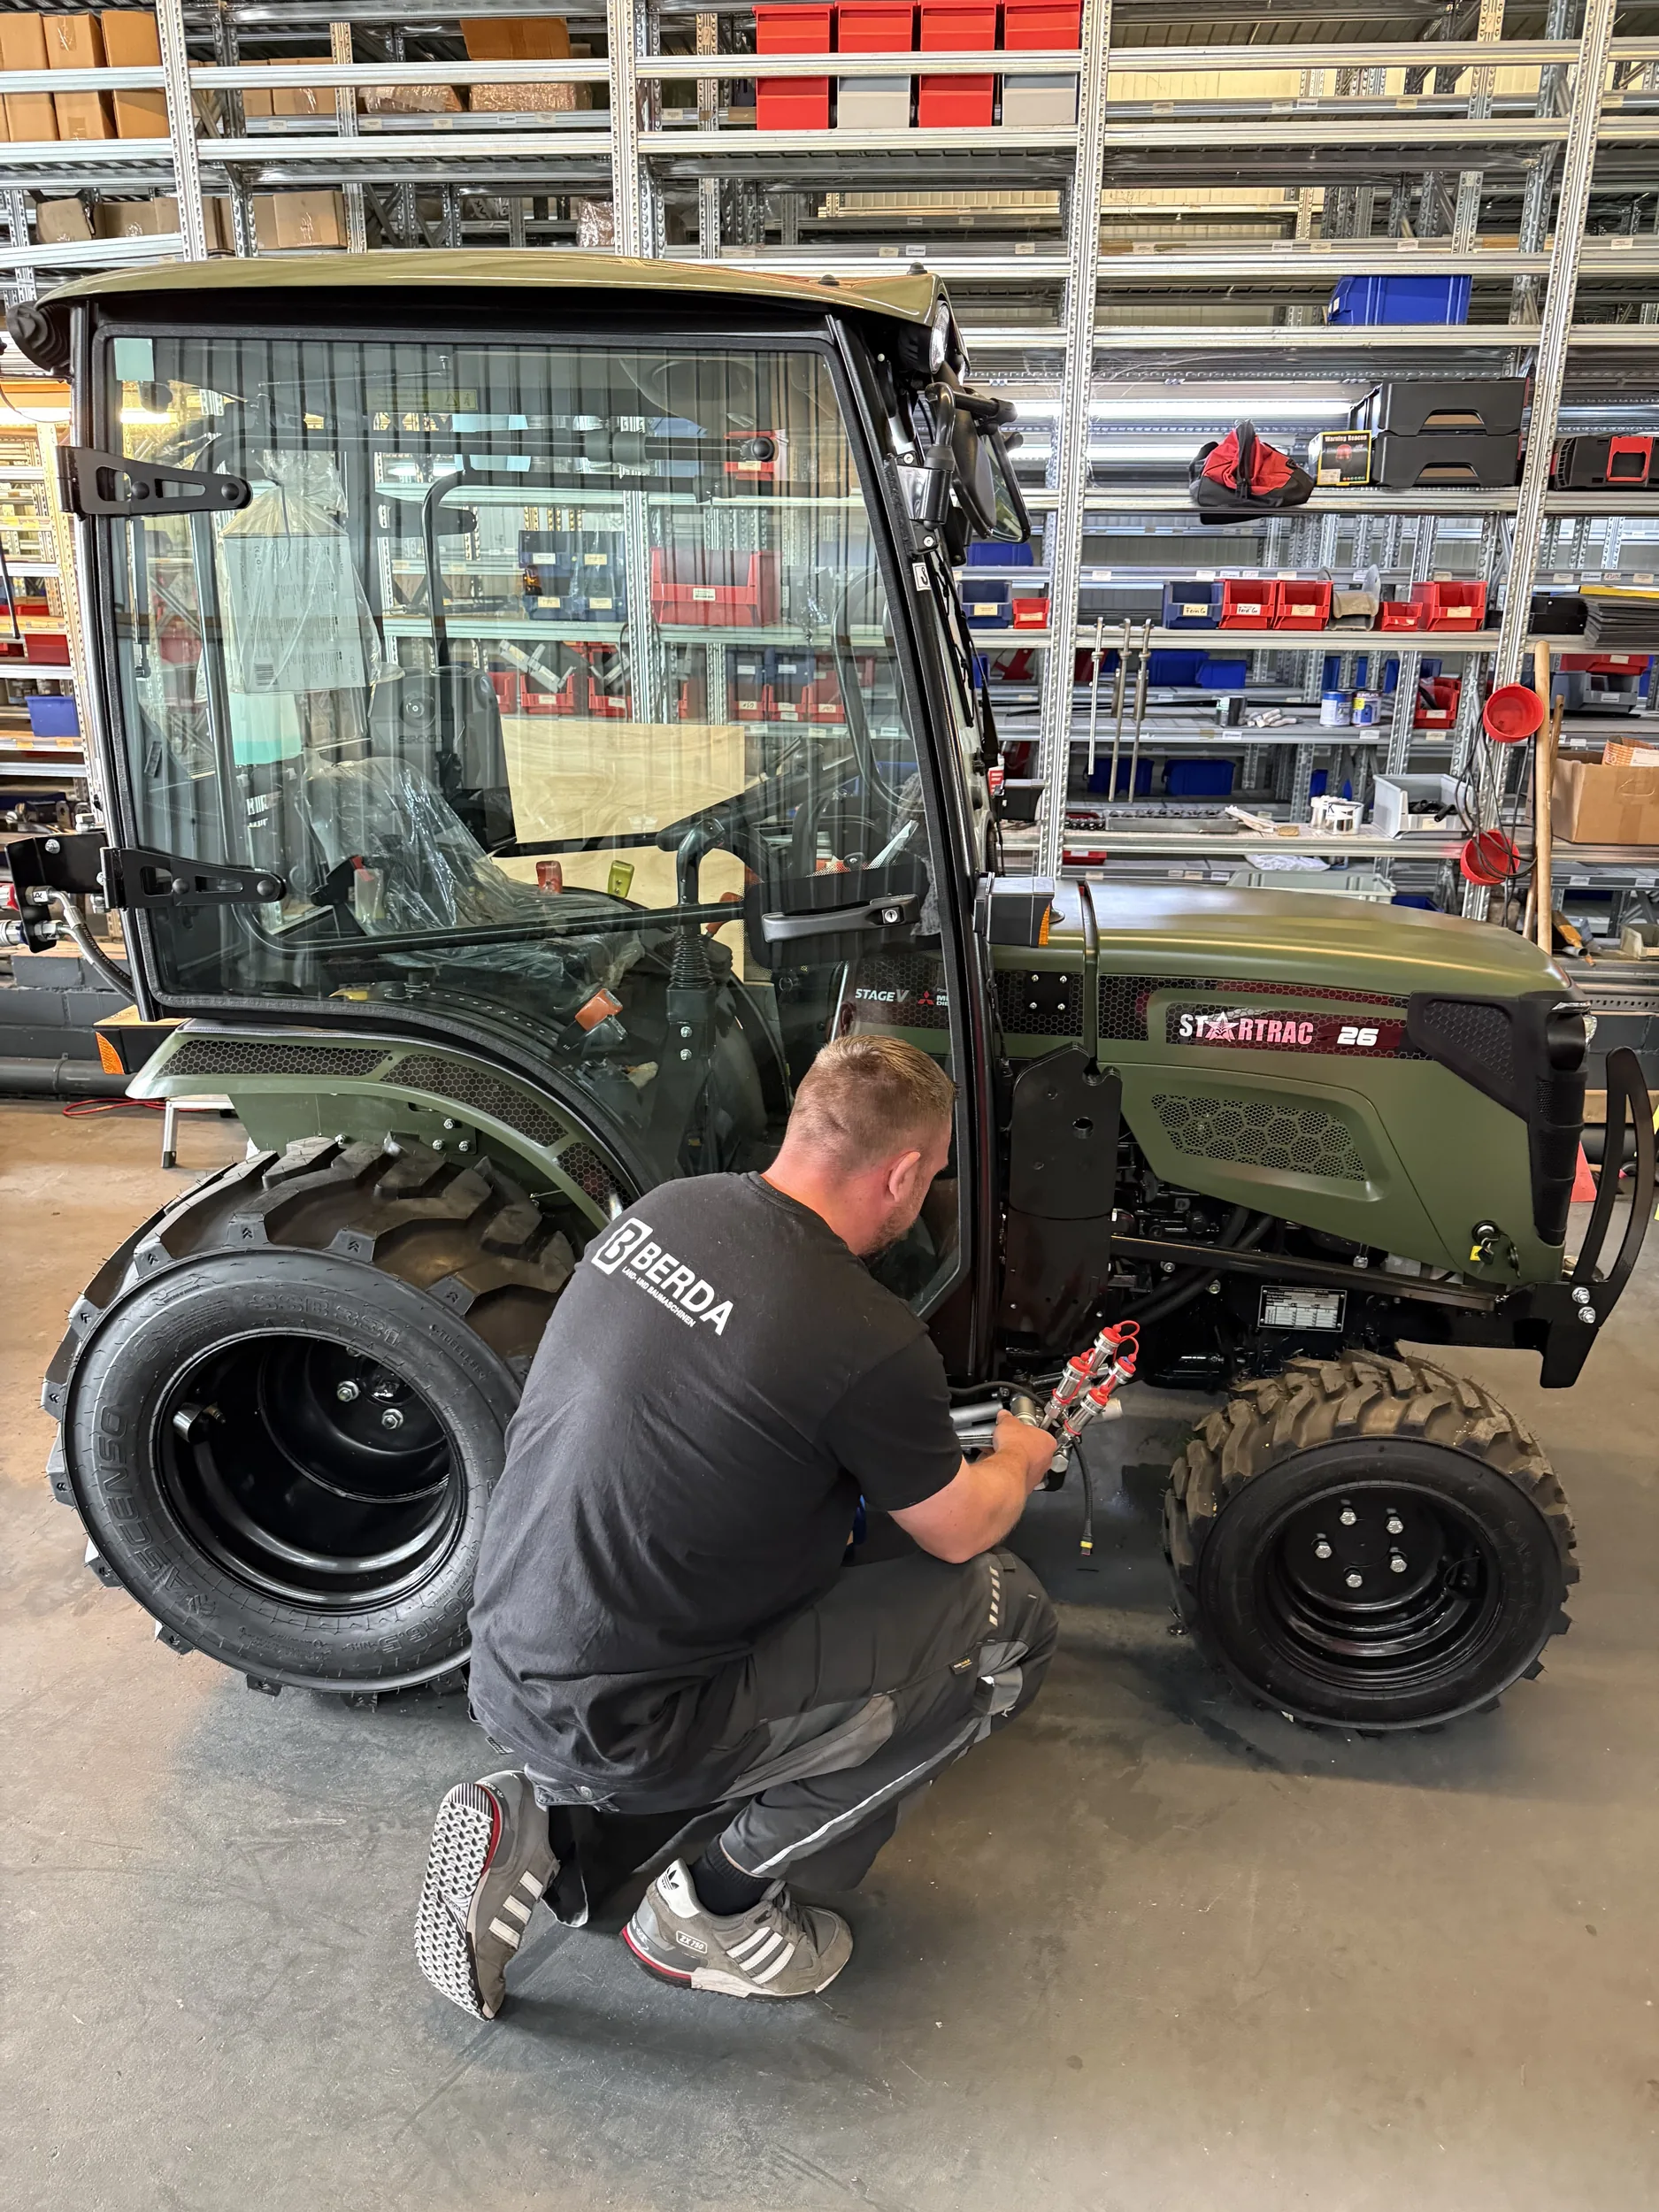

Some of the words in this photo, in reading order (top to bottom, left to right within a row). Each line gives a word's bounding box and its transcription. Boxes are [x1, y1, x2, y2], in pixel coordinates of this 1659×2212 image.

[1336, 1025, 1379, 1047] 26
[622, 1265, 637, 1280] LAND-
[636, 1277, 649, 1290] UND
[647, 1286, 696, 1327] BAUMASCHINEN
[630, 1241, 733, 1336] BERDA
[97, 1404, 198, 1594] ASCENSO
[680, 1935, 691, 1946] ZX
[691, 1939, 704, 1950] 750
